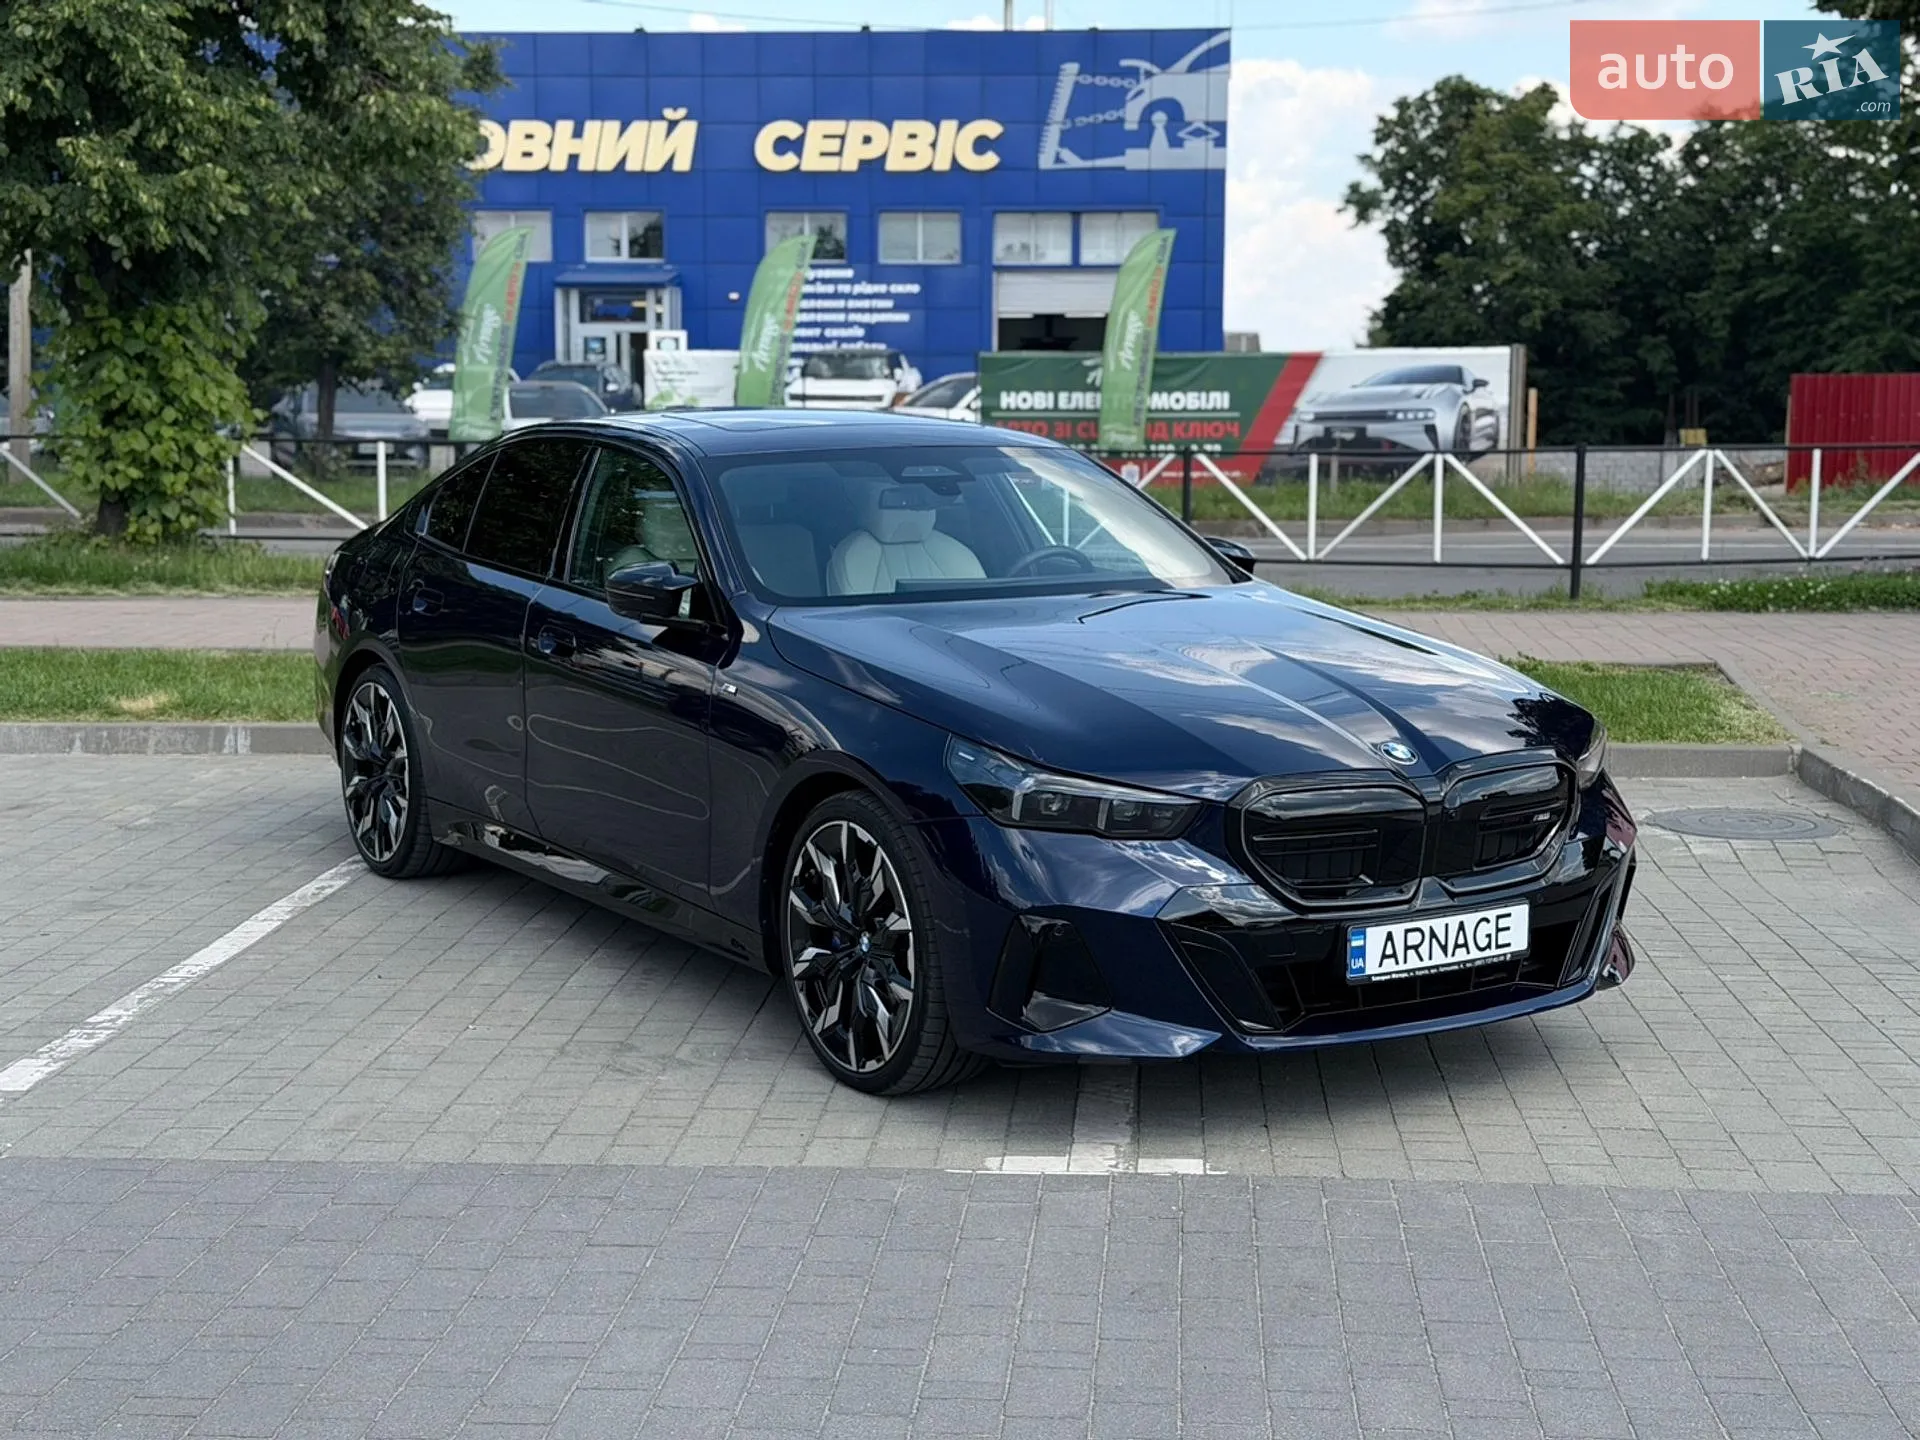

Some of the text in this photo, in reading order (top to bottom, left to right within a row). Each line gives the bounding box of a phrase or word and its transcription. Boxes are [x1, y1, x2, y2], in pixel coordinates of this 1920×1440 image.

[459, 107, 1004, 172] ОВНИЙ СЕРВІС
[1000, 391, 1055, 410] НОВІ
[1173, 421, 1240, 440] КЛЮЧ
[1378, 912, 1512, 968] ARNAGE
[1351, 957, 1364, 969] UA
